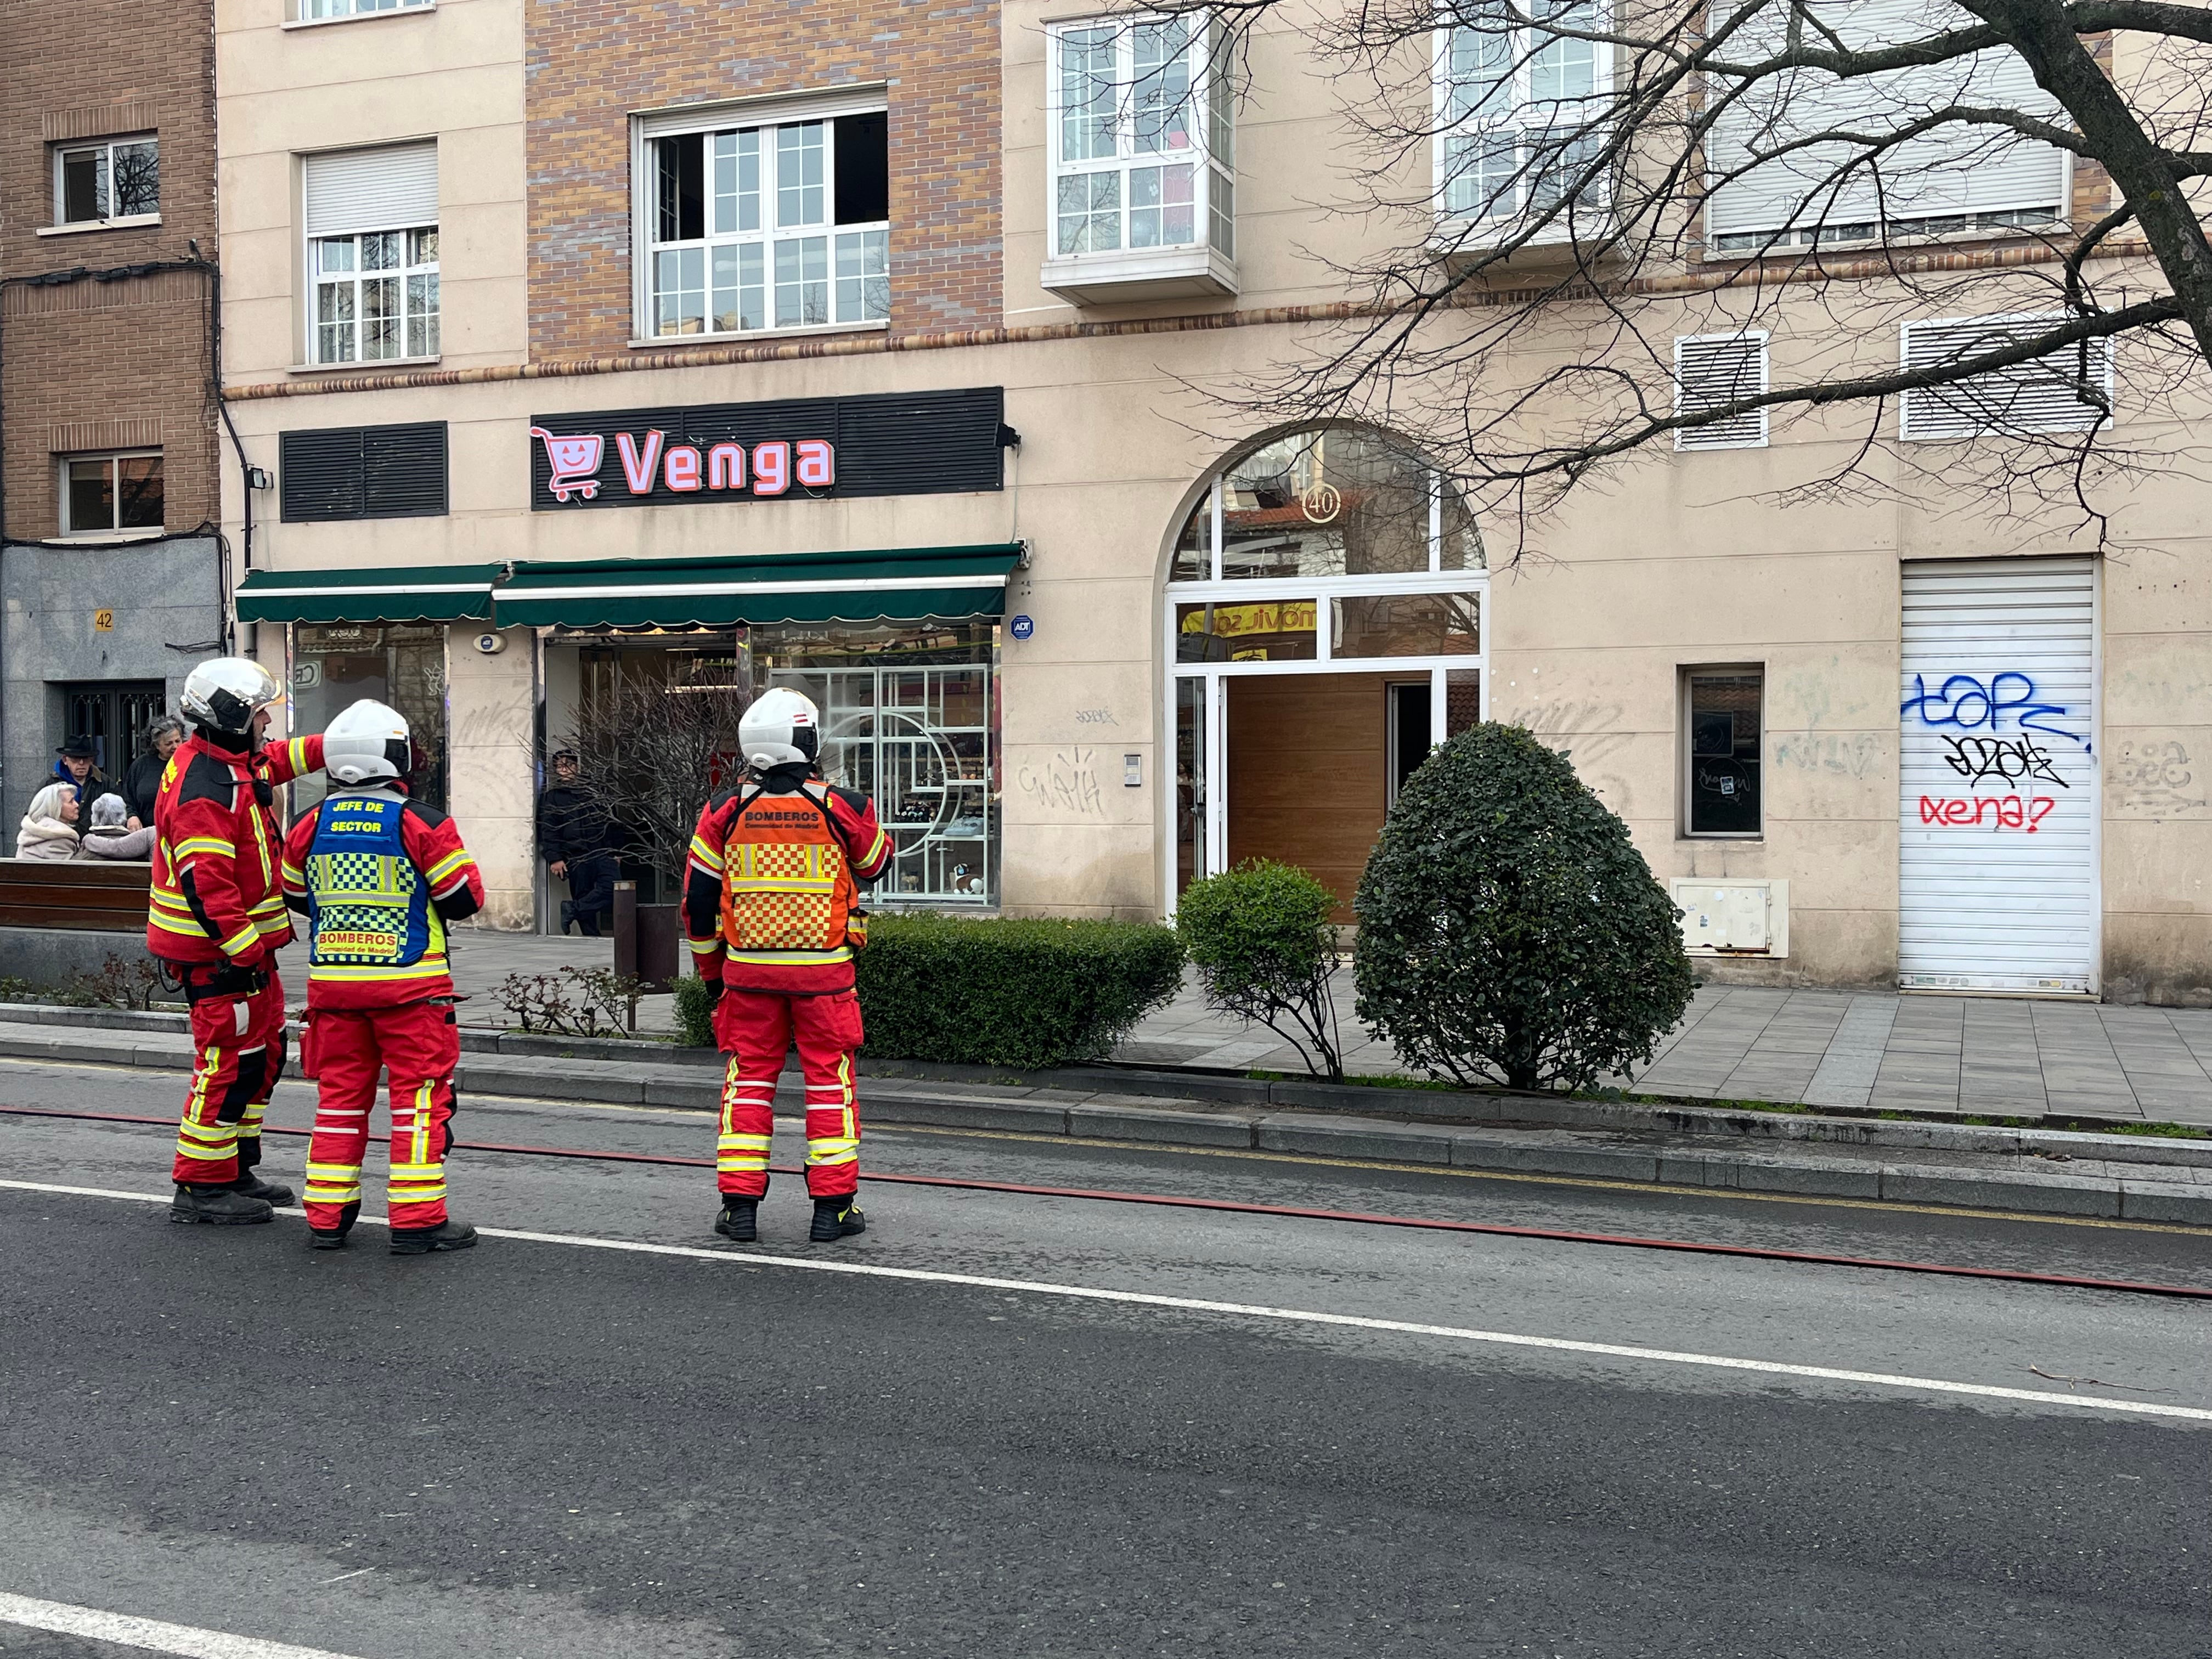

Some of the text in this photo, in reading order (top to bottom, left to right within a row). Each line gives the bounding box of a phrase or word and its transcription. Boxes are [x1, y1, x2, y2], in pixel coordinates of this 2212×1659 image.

[615, 430, 834, 496] Venga
[1309, 492, 1333, 514] 40
[97, 613, 112, 628] 42
[1014, 622, 1030, 631] ADT
[332, 801, 385, 813] JEFE DE
[745, 812, 819, 821] BOMBEROS
[330, 821, 382, 833] SECTOR
[319, 933, 396, 946] BOMBEROS
